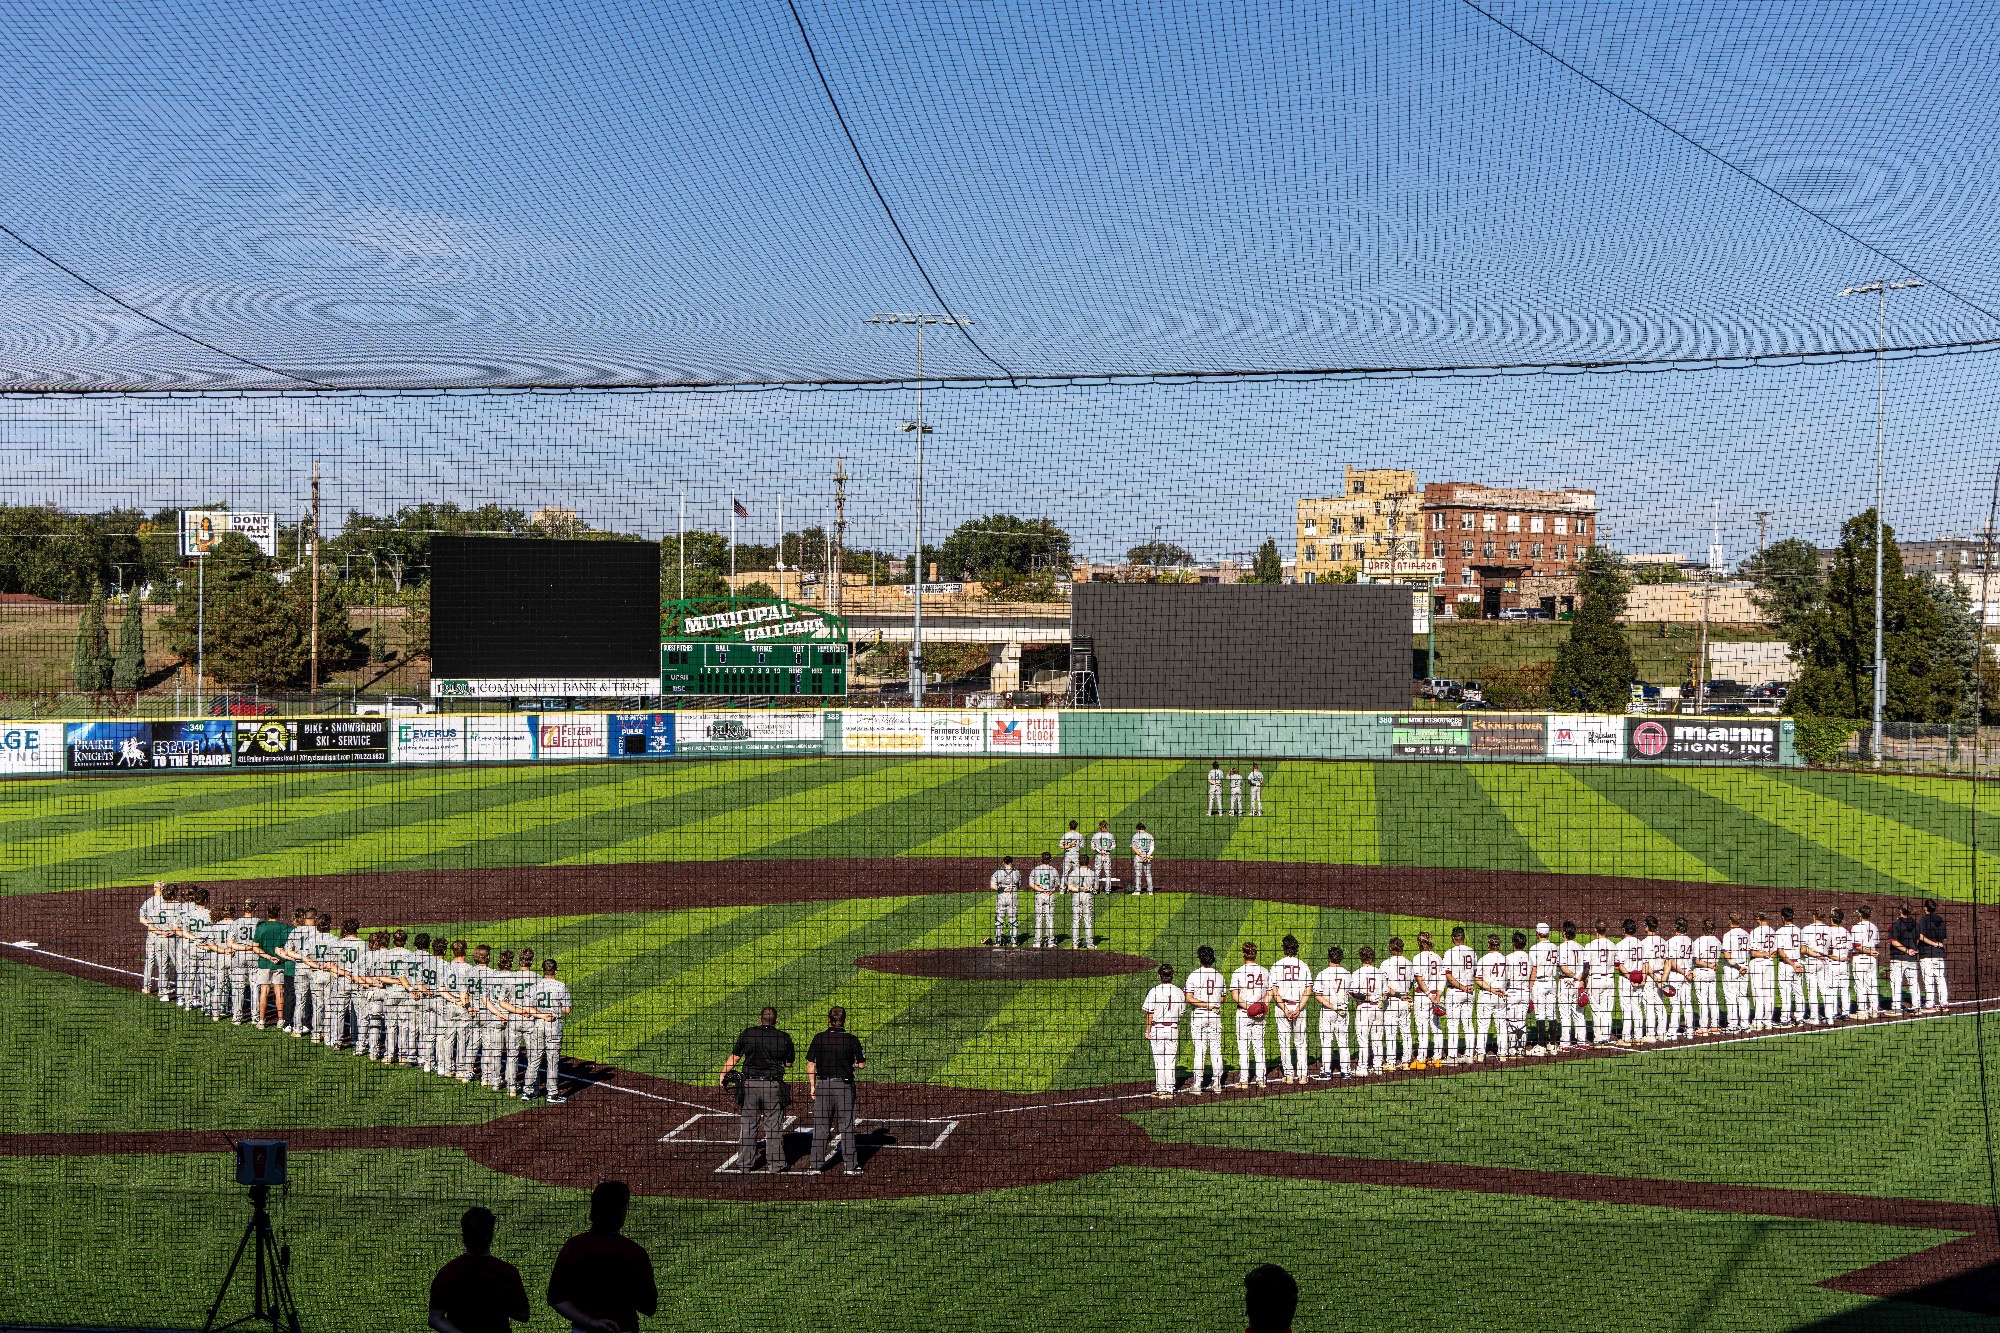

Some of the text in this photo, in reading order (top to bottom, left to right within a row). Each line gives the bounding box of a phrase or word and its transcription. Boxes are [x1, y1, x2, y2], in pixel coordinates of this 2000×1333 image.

[1412, 562, 1438, 570] PLAZA
[684, 603, 796, 634] MUNICIPAL
[745, 618, 825, 642] BALLPARK
[479, 683, 557, 693] COMMUNITY
[563, 683, 597, 693] BANK
[600, 683, 609, 692] &
[612, 683, 650, 693] TRUST
[304, 722, 382, 733] BIKE SNOWBOARD
[931, 727, 960, 735] Farmers
[1027, 719, 1055, 729] PITCH
[1488, 722, 1543, 730] KNIFE RIVER
[0, 731, 39, 750] GE
[316, 735, 371, 746] SKI SERVICE
[413, 729, 457, 738] EVERUS
[1027, 731, 1054, 741] CLOCK
[1674, 726, 1773, 742] mann
[74, 738, 114, 751] PRAIRIE
[153, 740, 201, 755] ESCAPE
[561, 737, 602, 747] ELECTRIC
[1741, 744, 1773, 754] INC
[74, 752, 114, 762] KNIGHTS
[153, 754, 232, 767] TO THE PRAIRIE
[159, 911, 166, 924] 6
[240, 927, 254, 941] 31
[340, 948, 357, 963] 30
[1546, 950, 1557, 964] 45
[1631, 947, 1642, 961] 20
[1654, 945, 1665, 959] 23
[1680, 945, 1692, 959] 34
[1710, 946, 1718, 959] 51
[1399, 967, 1406, 981] 5
[1431, 961, 1437, 975] 3
[1492, 963, 1506, 977] 47
[1518, 962, 1527, 976] 13
[449, 974, 456, 989] 3
[1247, 974, 1263, 989] 24
[1335, 979, 1342, 993] 7
[537, 992, 551, 1008] 21
